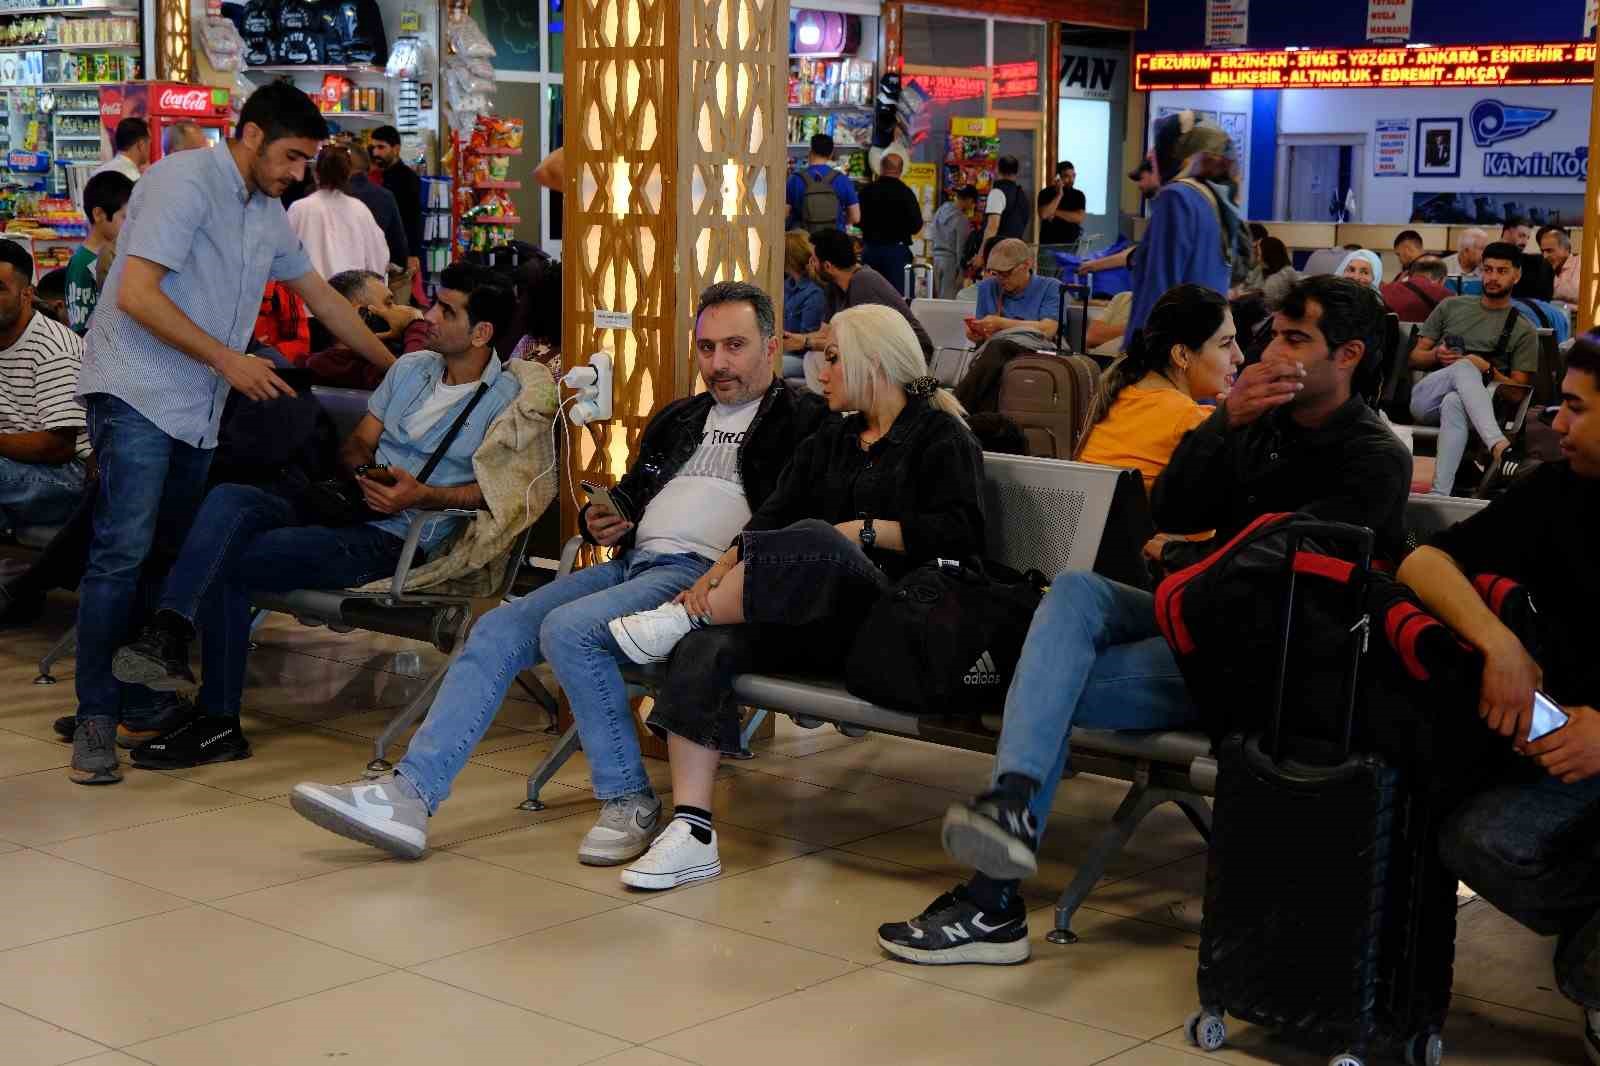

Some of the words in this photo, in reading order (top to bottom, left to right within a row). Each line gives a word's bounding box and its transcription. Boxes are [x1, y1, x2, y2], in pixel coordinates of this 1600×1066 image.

[1150, 57, 1211, 70] ERZURUM
[1349, 52, 1407, 66] YOZGAT
[1416, 50, 1479, 64] ANKARA
[1290, 67, 1370, 83] ALTINOLUK
[1381, 65, 1445, 81] EDREMİT
[1455, 65, 1510, 83] AKÇAY
[963, 671, 1001, 685] adidas
[200, 727, 233, 748] SALOMON
